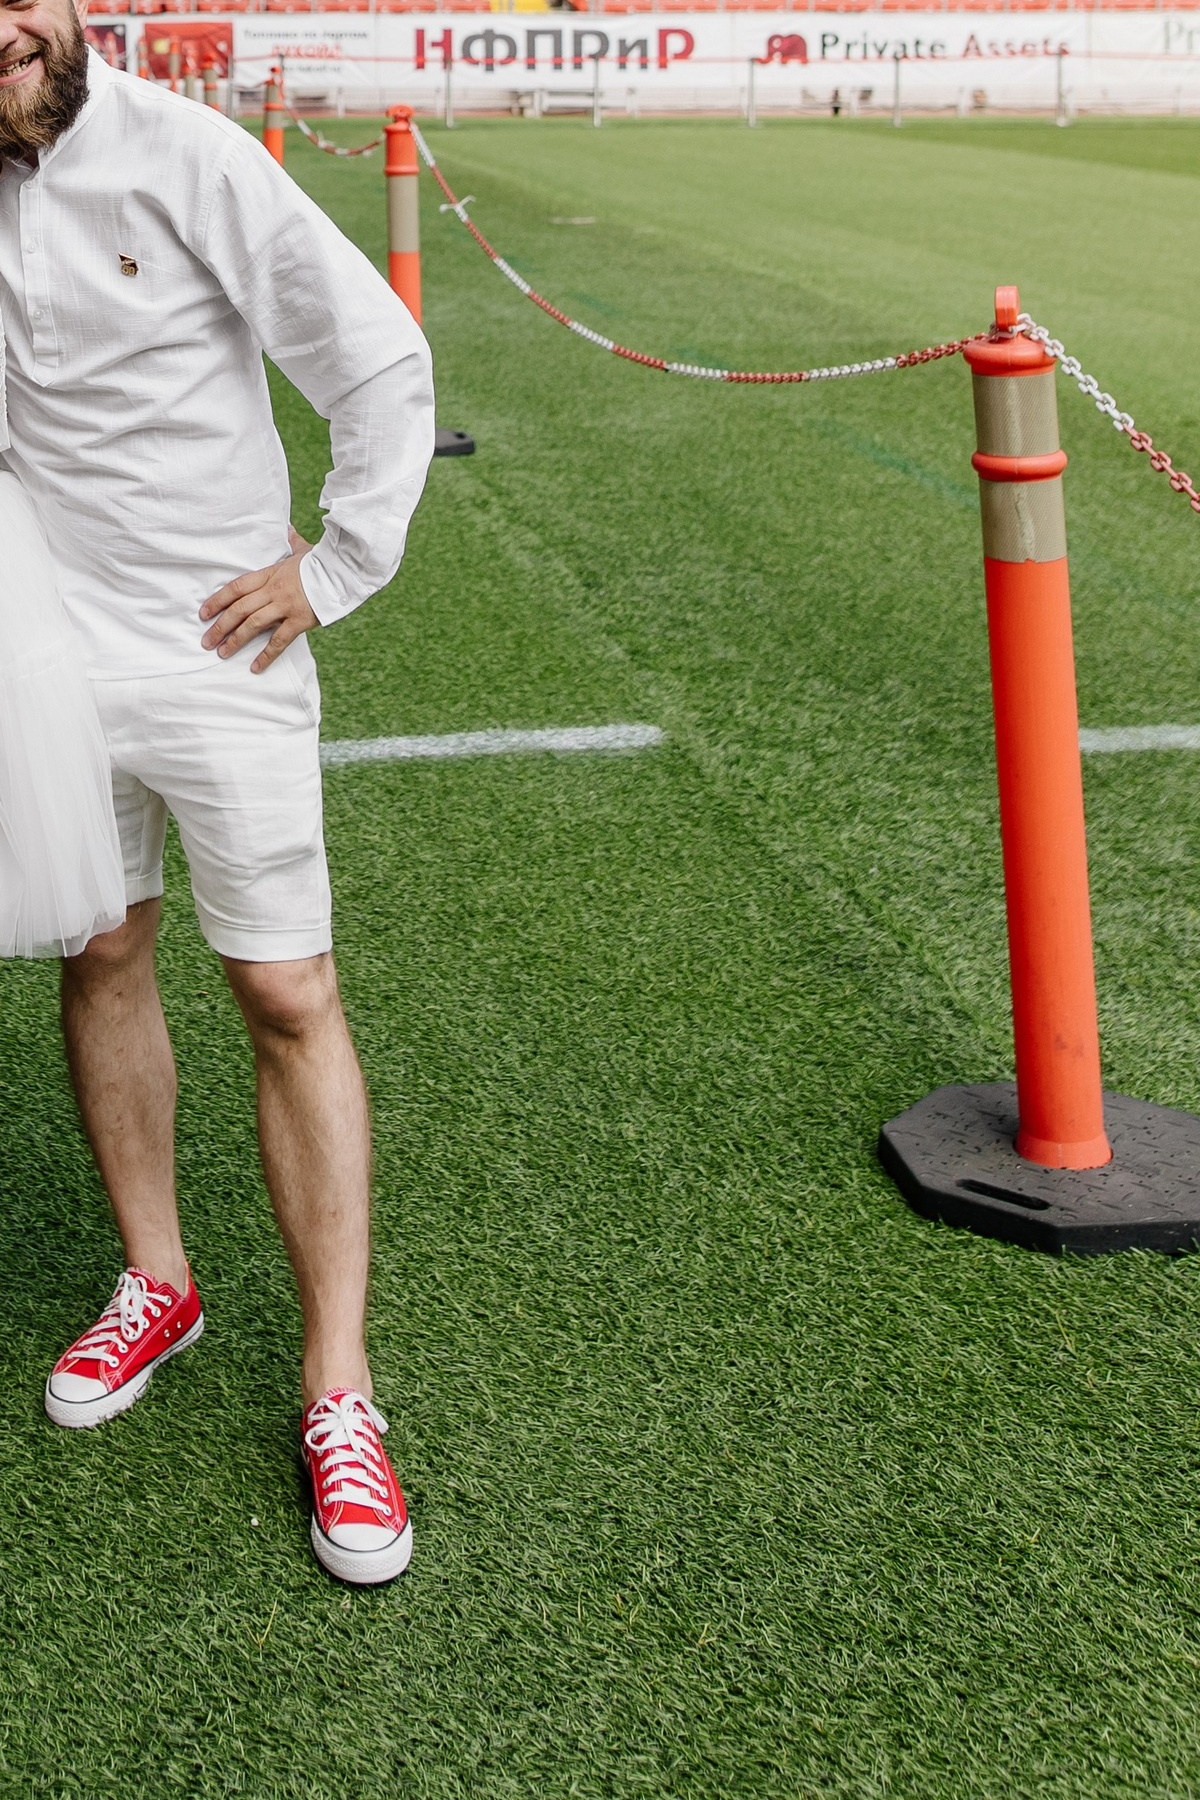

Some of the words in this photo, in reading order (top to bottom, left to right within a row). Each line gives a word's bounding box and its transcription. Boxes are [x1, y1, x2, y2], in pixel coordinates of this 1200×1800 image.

[415, 28, 695, 72] НФПРиР
[819, 32, 947, 60] Private
[962, 32, 1070, 58] Assets
